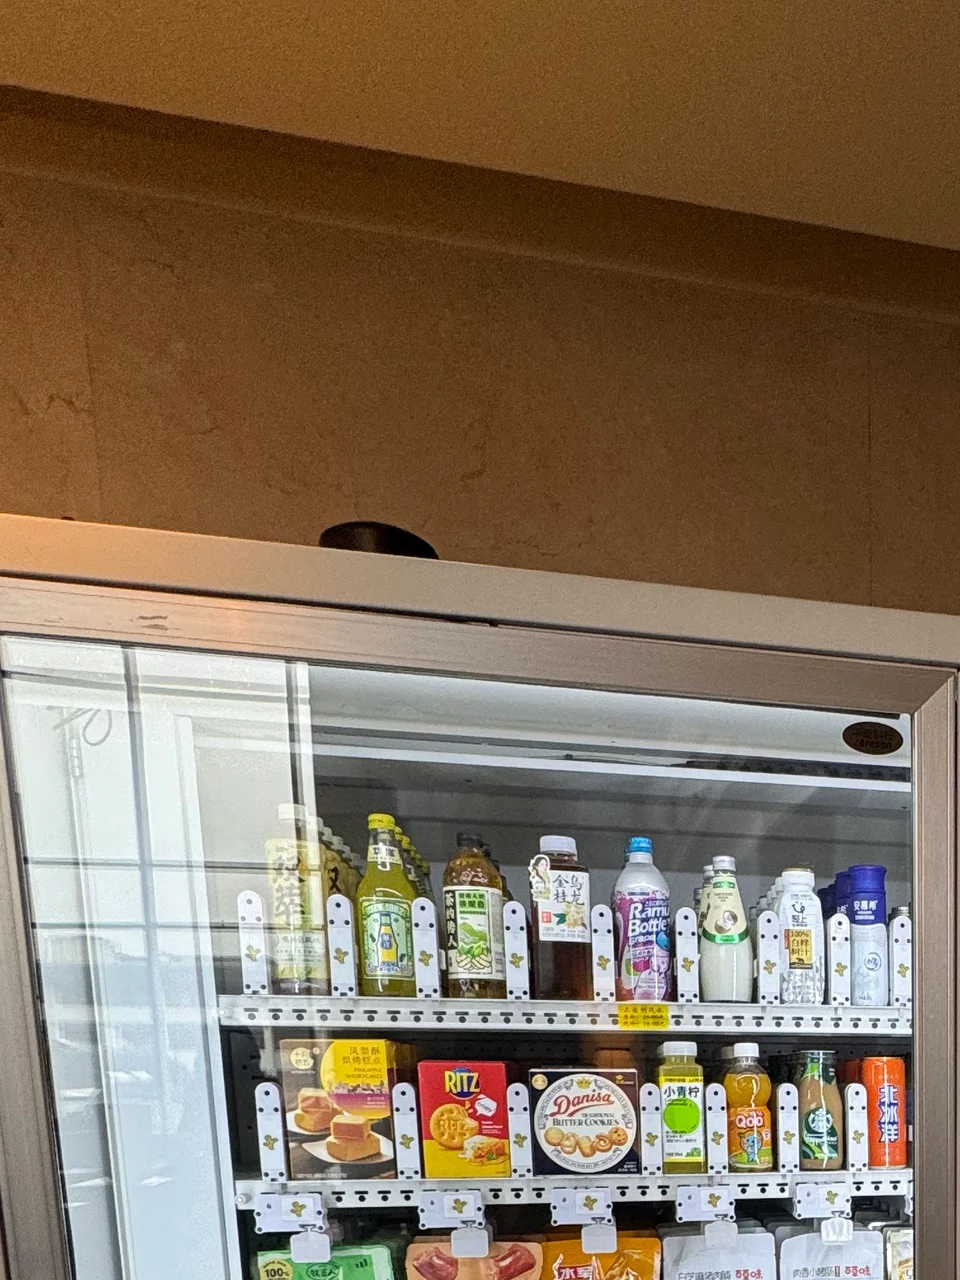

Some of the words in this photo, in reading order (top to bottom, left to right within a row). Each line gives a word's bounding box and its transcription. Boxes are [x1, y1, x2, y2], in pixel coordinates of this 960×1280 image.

[552, 874, 569, 903] 金桂
[570, 874, 585, 905] 乌龙
[854, 901, 877, 911] 安慕希
[629, 917, 668, 937] Bottle
[444, 1071, 480, 1093] RITZ
[663, 1086, 700, 1098] 小青柠
[550, 1089, 615, 1117] Danisa
[737, 1114, 764, 1127] Qoo
[878, 1085, 898, 1143] 北冰洋
[553, 1118, 583, 1126] BUTTER
[585, 1118, 619, 1126] COOKIES
[264, 1267, 290, 1278] 100%
[735, 1269, 763, 1280] 百草味
[845, 1266, 871, 1276] 百草味
